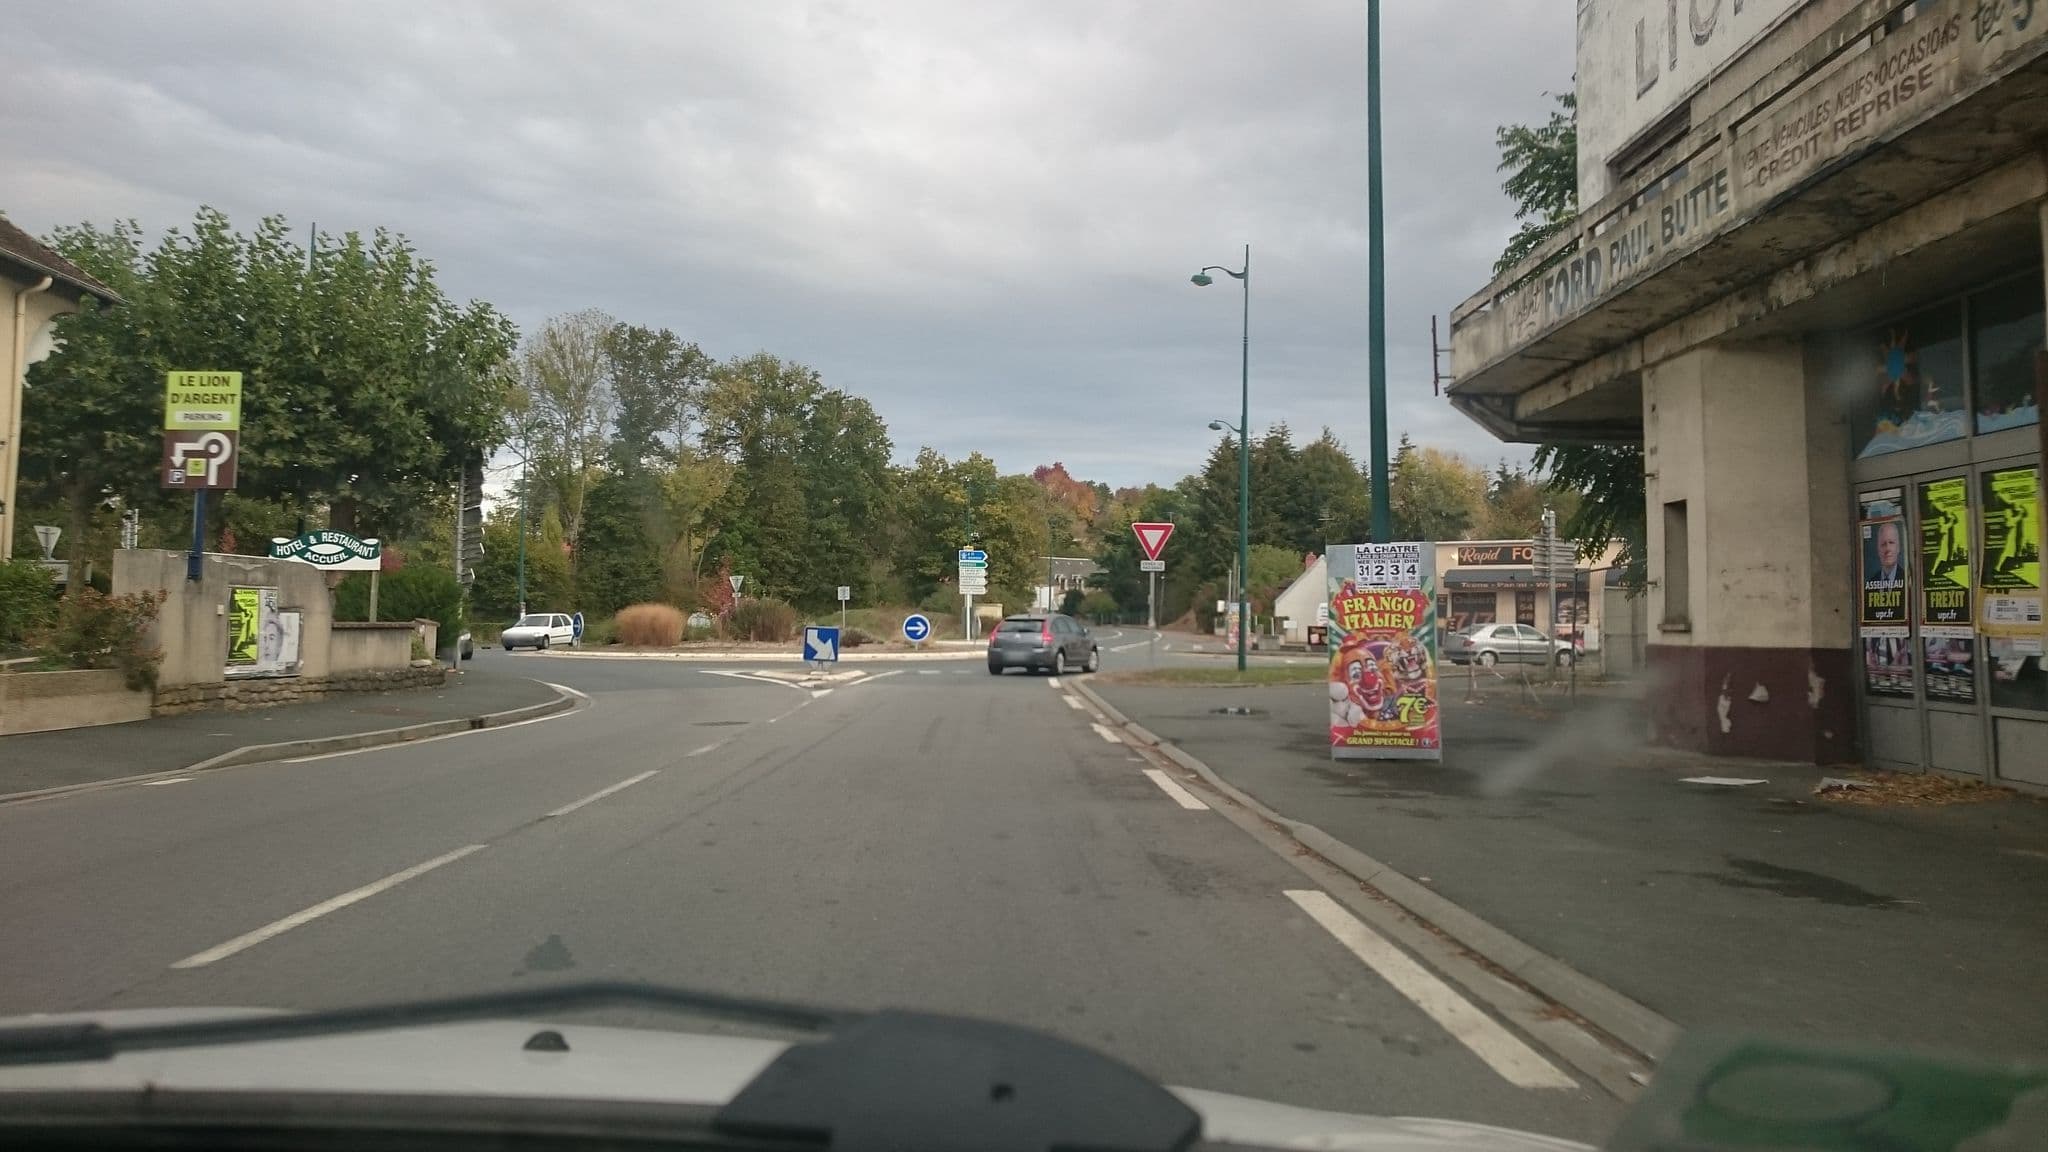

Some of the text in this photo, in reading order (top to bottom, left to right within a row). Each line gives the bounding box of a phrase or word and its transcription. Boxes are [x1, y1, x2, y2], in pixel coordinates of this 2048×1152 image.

[1635, 0, 1744, 100] LIO
[1832, 63, 1934, 144] REPRISE
[1544, 246, 1603, 317] FORD
[1609, 219, 1655, 275] PAUL
[1661, 167, 1729, 246] BUTTE
[180, 375, 231, 387] LE LION
[170, 393, 237, 405] D'ARGENT
[183, 413, 223, 421] PARKING
[276, 532, 375, 558] HOTEL & RESTAURANT
[1374, 545, 1418, 553] CHATRE
[304, 551, 349, 564] ACCUEIL
[1459, 547, 1501, 564] Rapid
[1359, 564, 1417, 576] 31 2 3 4
[1865, 579, 1904, 590] ASSELINEAU
[1868, 591, 1901, 608] FREXIT
[1930, 591, 1965, 608] FREXIT
[1343, 612, 1415, 631] ITALIEN
[1346, 737, 1373, 745] GRAND
[1374, 737, 1415, 746] SPECTACLE
